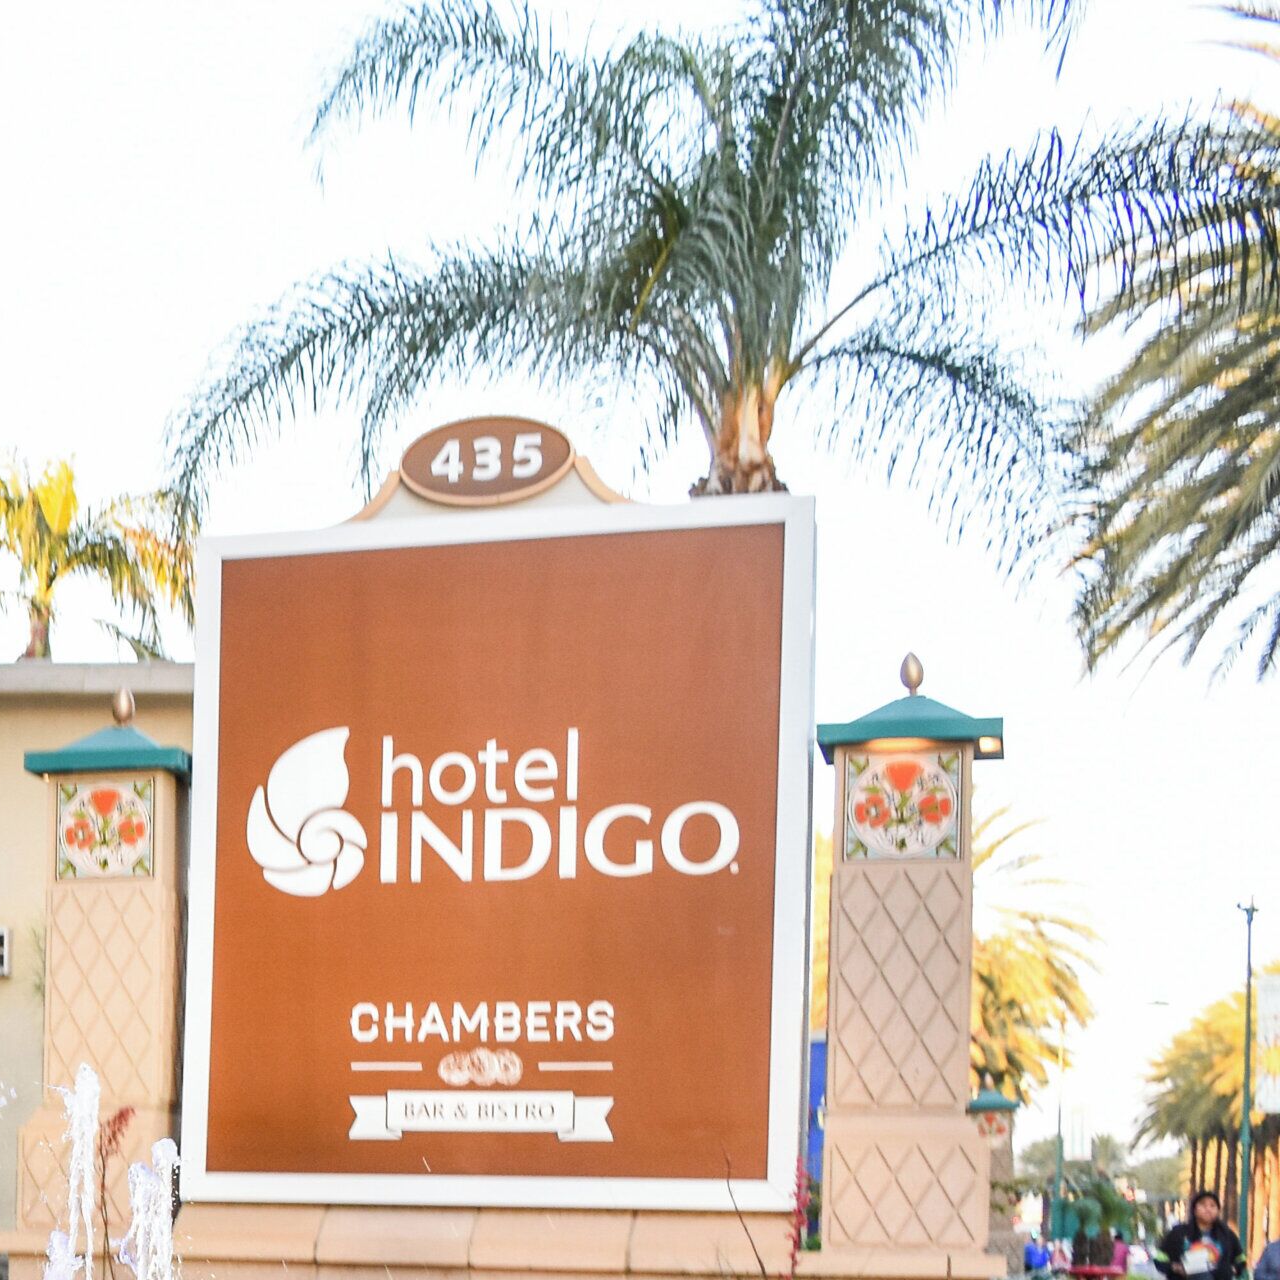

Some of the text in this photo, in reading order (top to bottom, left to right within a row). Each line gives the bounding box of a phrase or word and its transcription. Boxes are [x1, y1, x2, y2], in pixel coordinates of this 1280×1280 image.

[430, 433, 543, 484] 435
[381, 727, 579, 807] hotel
[379, 800, 741, 884] INDIGO
[349, 1000, 615, 1043] CHAMBERS
[403, 1101, 556, 1121] BAR & BISTRO
